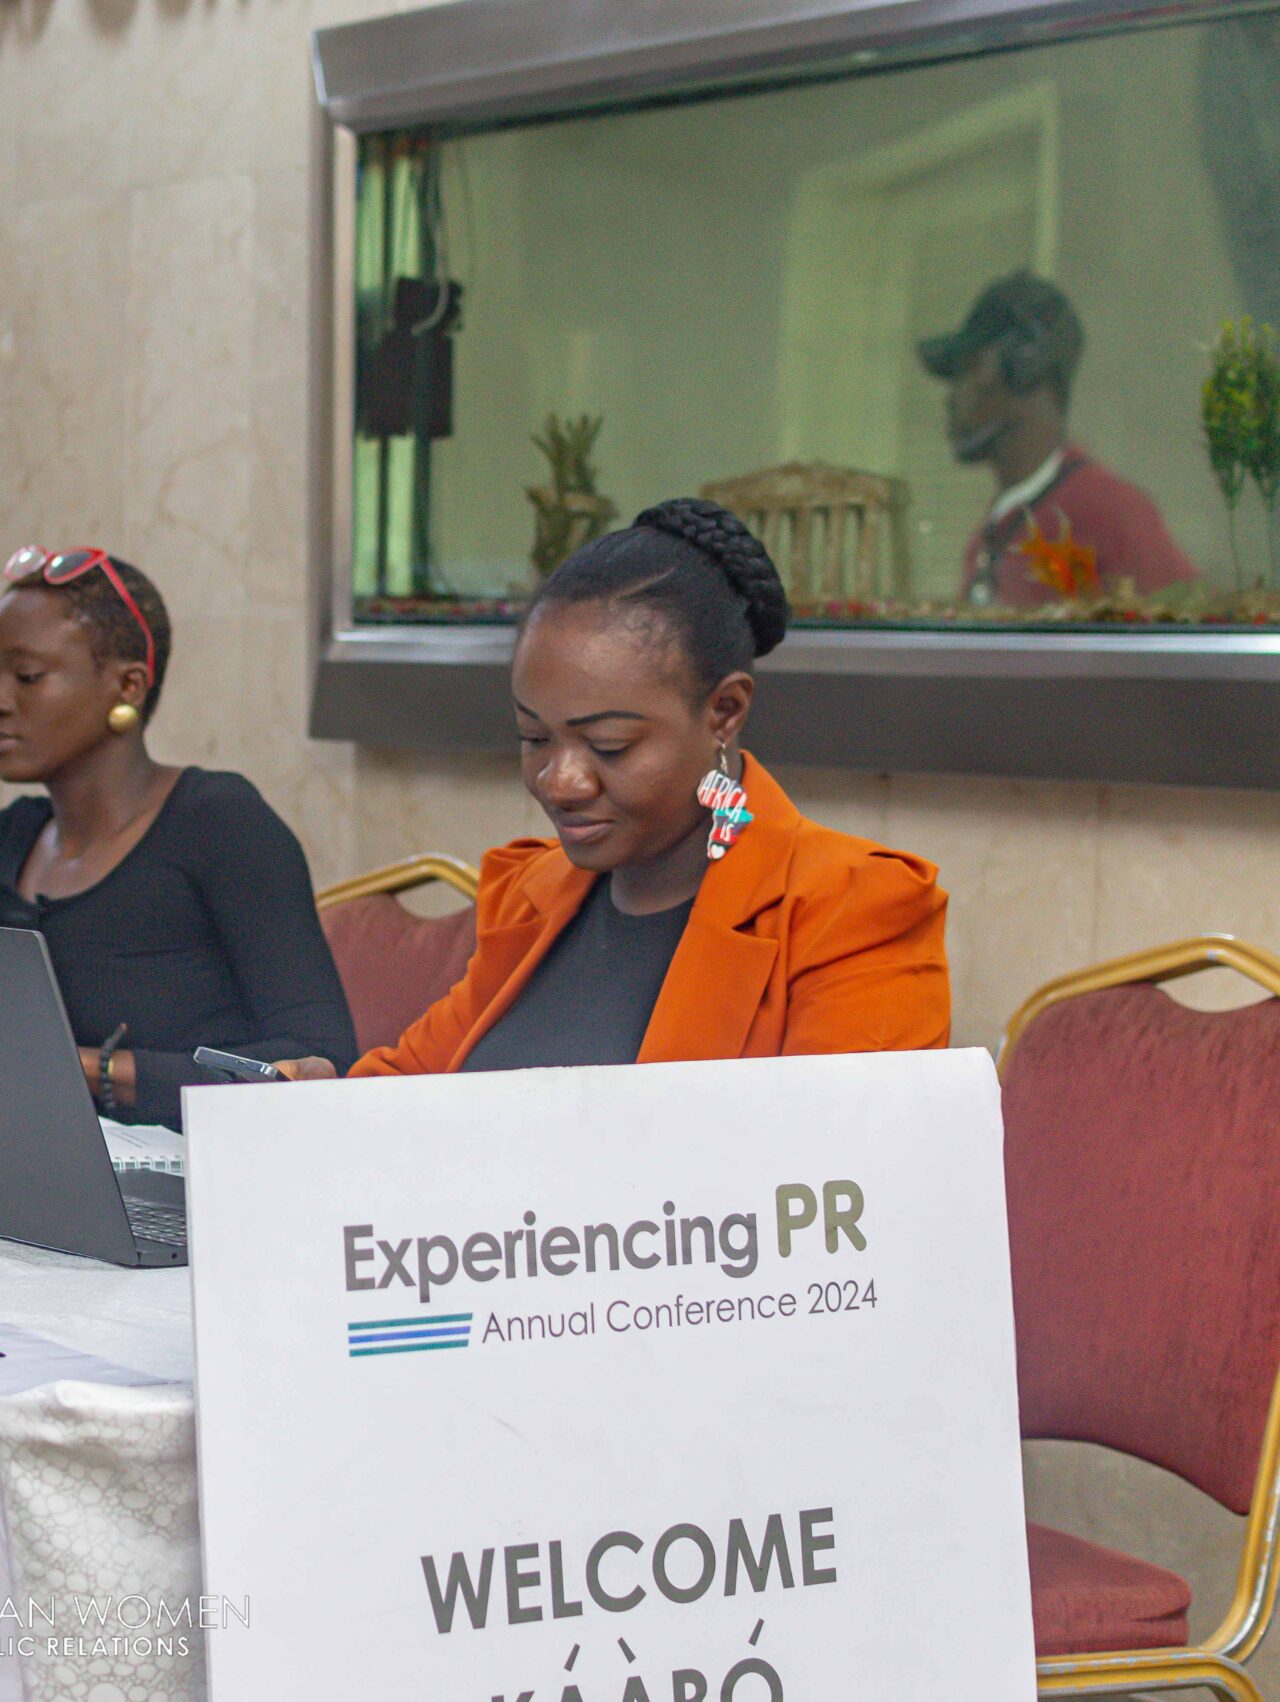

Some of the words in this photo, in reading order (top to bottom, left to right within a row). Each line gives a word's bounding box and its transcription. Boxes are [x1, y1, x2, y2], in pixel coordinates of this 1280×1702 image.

[699, 772, 747, 822] AFRICA
[343, 1200, 759, 1302] Experiencing
[774, 1179, 869, 1258] PR
[482, 1302, 596, 1344] Annual
[606, 1287, 798, 1334] Conference
[807, 1279, 878, 1315] 2024
[420, 1506, 839, 1635] WELCOME
